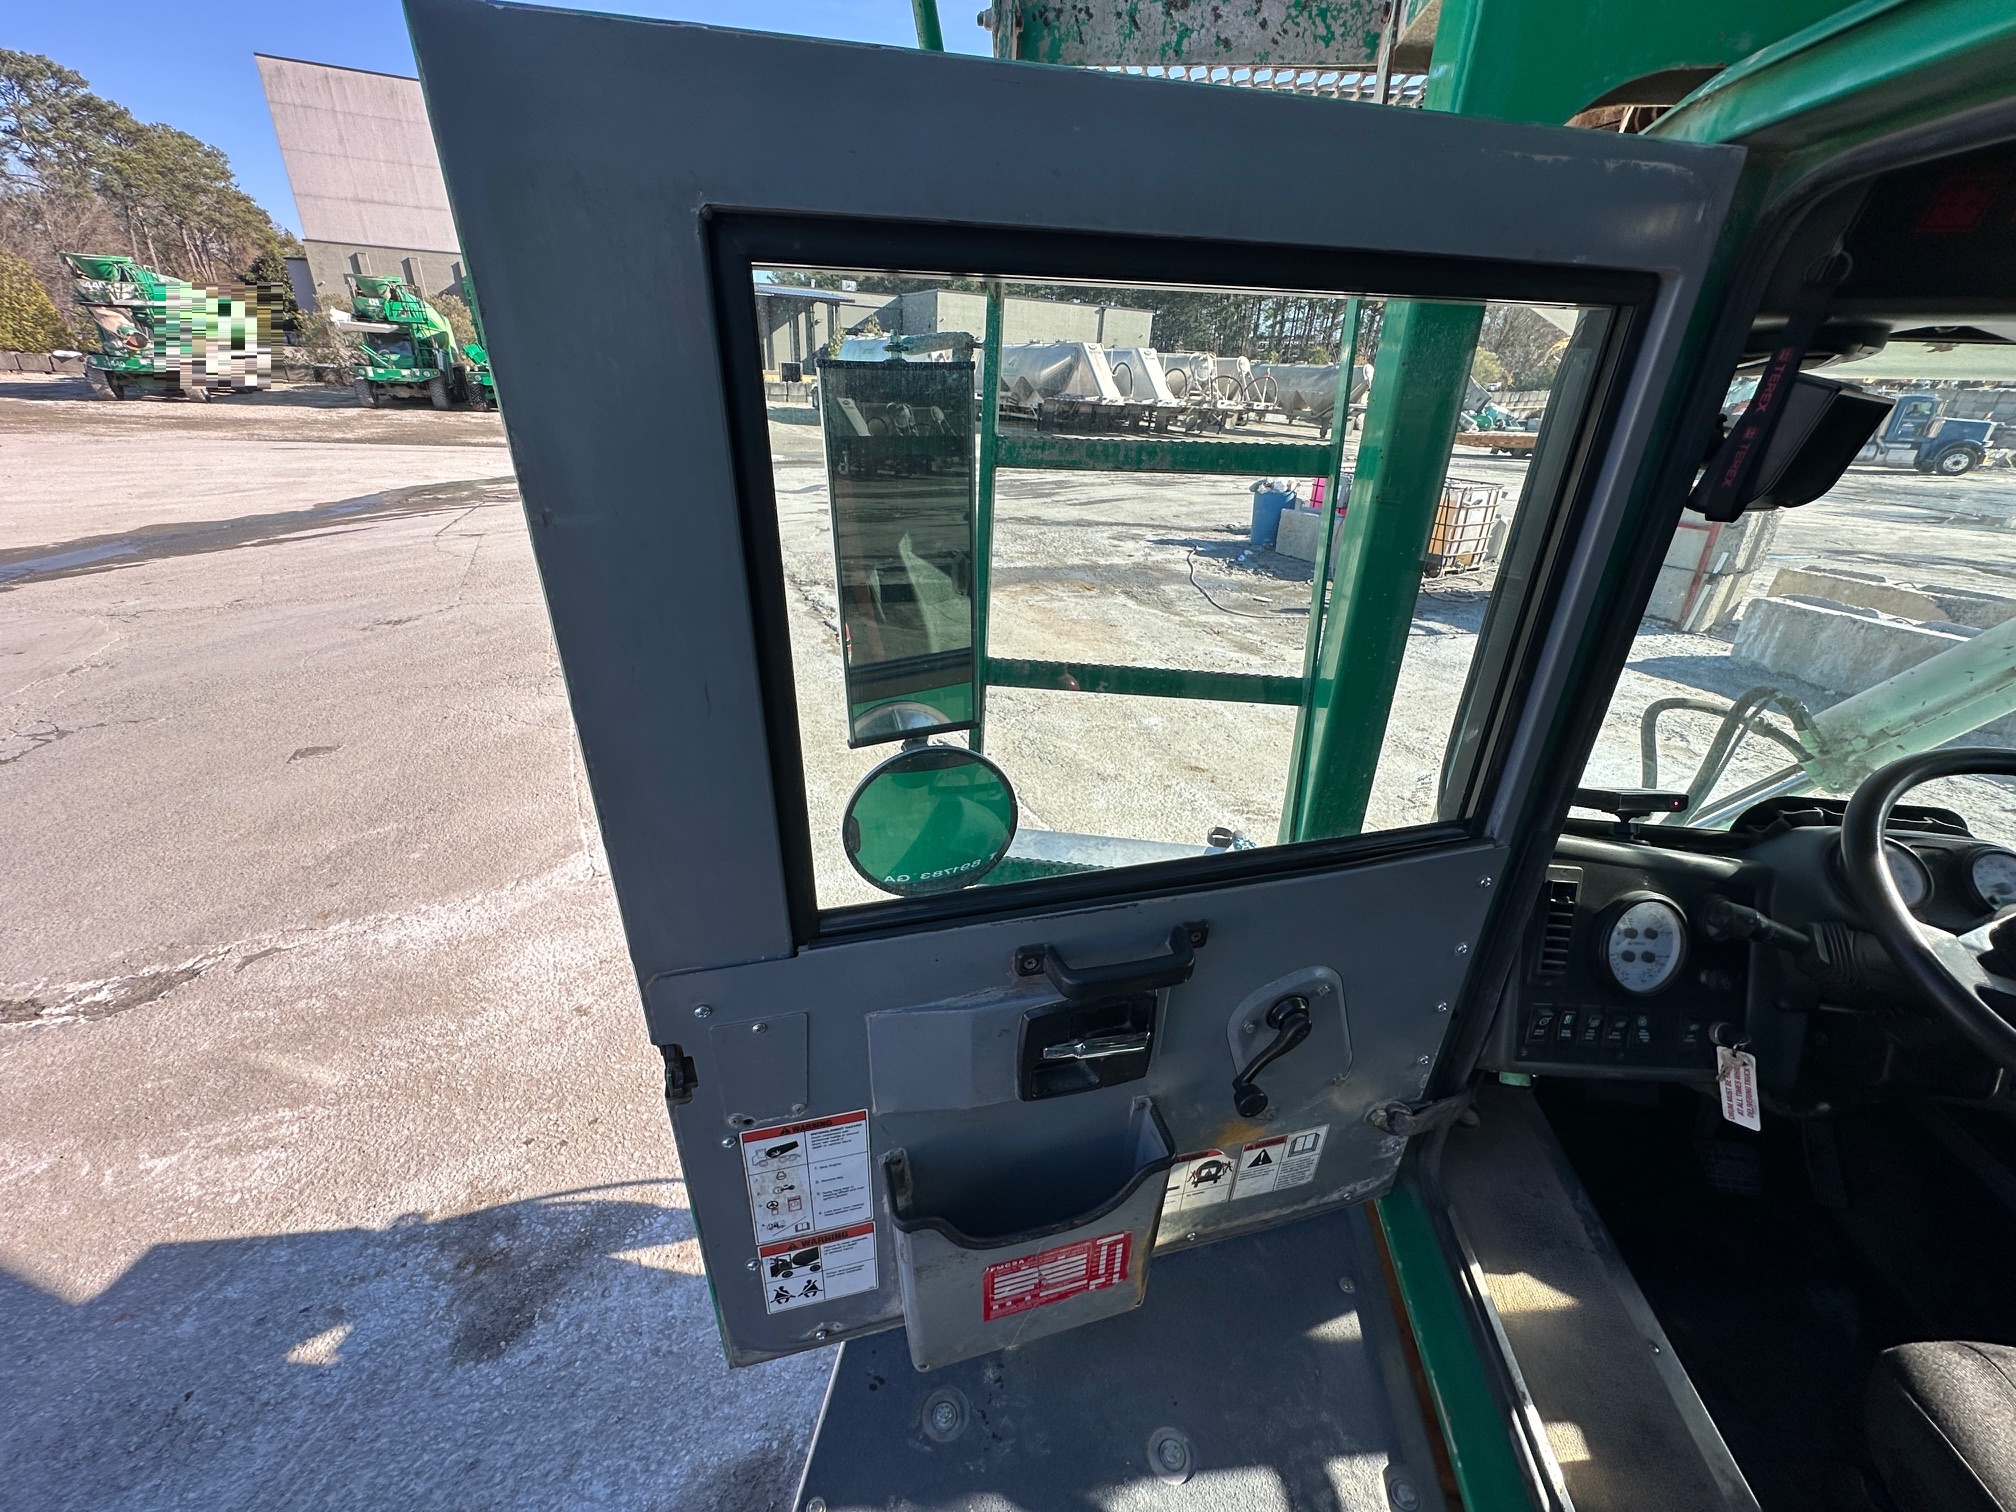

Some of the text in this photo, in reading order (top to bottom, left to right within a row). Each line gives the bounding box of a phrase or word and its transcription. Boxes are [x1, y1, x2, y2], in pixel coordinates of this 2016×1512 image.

[1756, 366, 1787, 412] TEREX
[1723, 443, 1751, 487] TEREX
[1725, 1079, 1732, 1087] BE
[1725, 1087, 1733, 1104] MUST
[1746, 1086, 1754, 1118] DELIVERING
[1727, 1103, 1735, 1120] DRUM
[1736, 1107, 1744, 1117] AT
[792, 1120, 832, 1133] WARNING
[801, 1231, 849, 1247] WARNING
